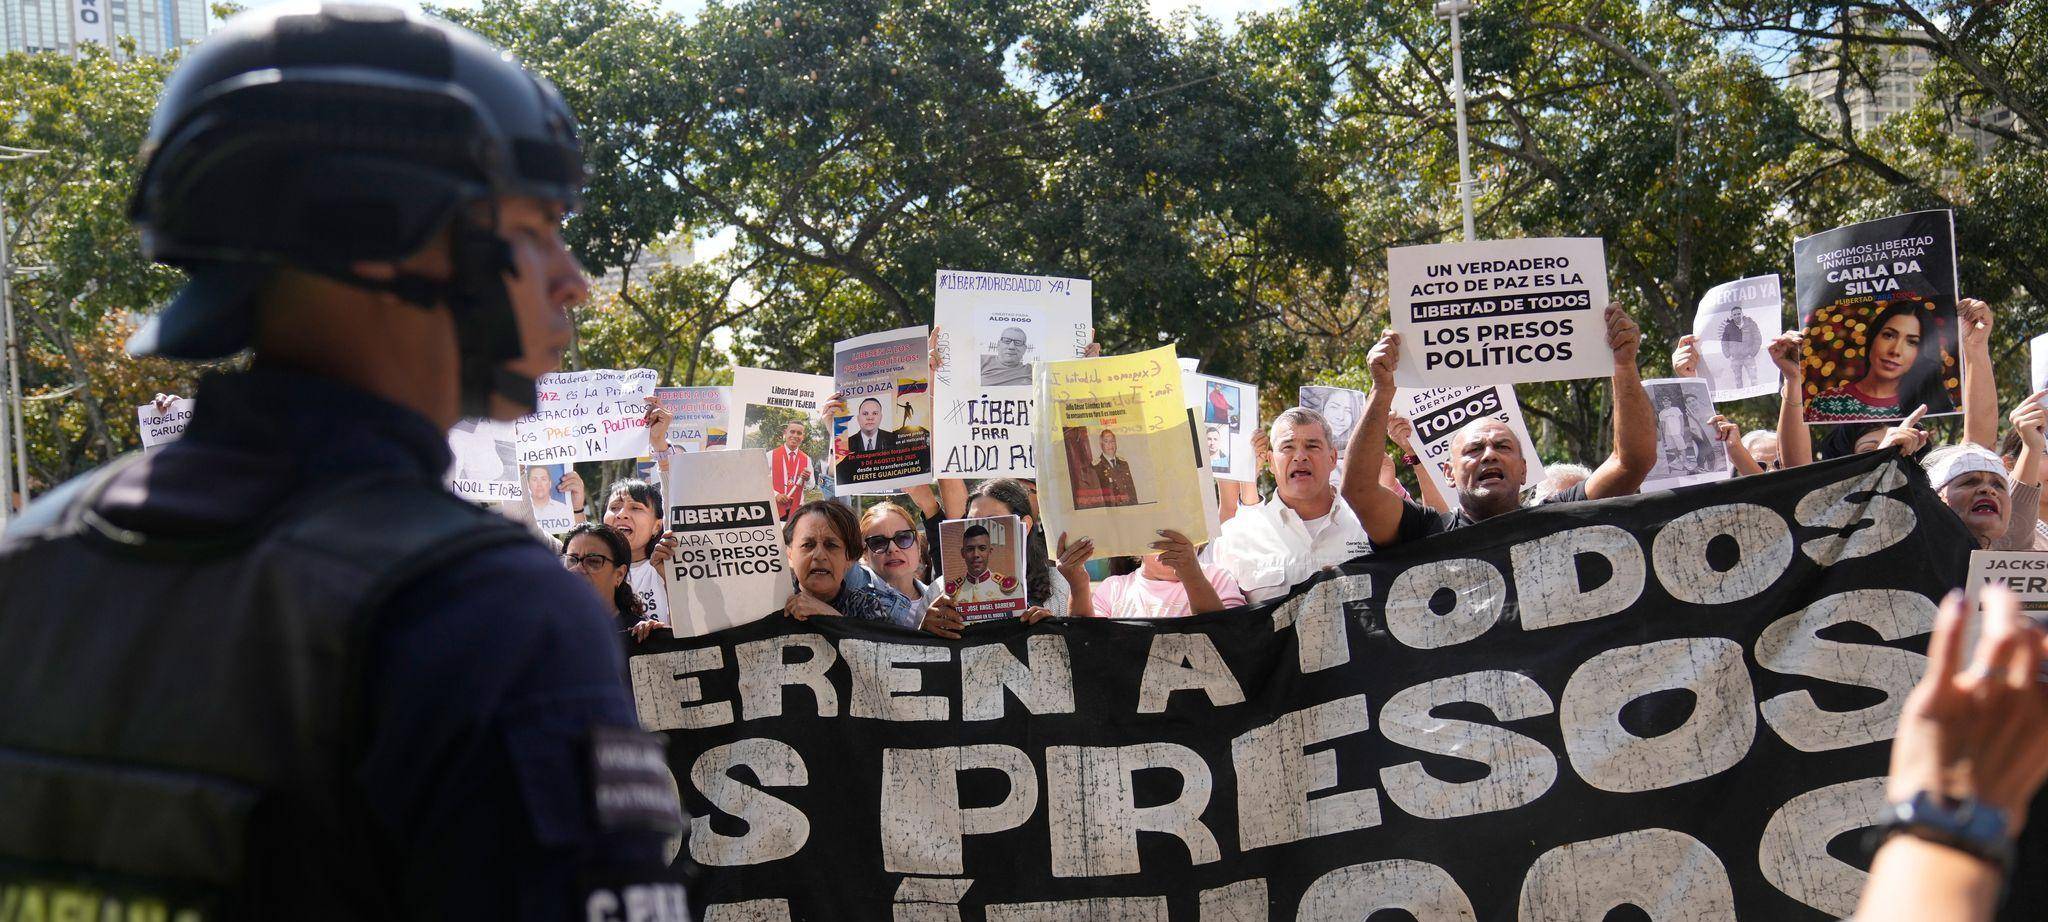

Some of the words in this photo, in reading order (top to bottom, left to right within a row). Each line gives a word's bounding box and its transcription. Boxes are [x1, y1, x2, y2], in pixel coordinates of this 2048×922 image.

[1816, 244, 1873, 264] EXIGIMOS
[1875, 236, 1934, 252] LIBERTAD
[1823, 251, 1889, 270] INMEDIATA
[1891, 247, 1925, 260] PARA
[1427, 264, 1452, 277] UN
[1457, 256, 1569, 275] VERDADERO
[1826, 263, 1889, 283] CARLA
[1893, 260, 1921, 275] DA
[1410, 282, 1459, 297] ACTO
[1464, 279, 1488, 292] DE
[1494, 276, 1529, 290] PAZ
[1534, 274, 1555, 287] ES
[1561, 273, 1584, 285] LA
[1760, 282, 1777, 298] YA
[1845, 278, 1900, 296] SILVA
[1412, 301, 1497, 320] LIBERTAD
[1501, 298, 1524, 312] DE
[1528, 294, 1589, 310] TODOS
[1424, 327, 1470, 346] LOS
[1477, 319, 1574, 341] PRESOS
[1426, 342, 1573, 371] POLÍTICOS
[771, 386, 798, 397] Libertad
[799, 389, 815, 399] para
[840, 387, 864, 397] USTO
[867, 382, 893, 393] DAZA
[767, 397, 794, 408] KENNEDY
[795, 399, 816, 410] TEJEDA
[1409, 390, 1462, 416] LIBERTAD
[1417, 393, 1498, 438] TODOS
[672, 429, 702, 439] DAZA
[971, 427, 1008, 440] PARA
[586, 436, 609, 456] YA!
[1425, 440, 1449, 459] LOS
[856, 466, 872, 474] desde
[880, 461, 913, 470] transferencia
[941, 444, 998, 472] ALDO
[852, 472, 877, 481] FUERTE
[877, 466, 921, 478] GUAICAIPURO
[671, 506, 766, 525] LIBERTAD
[716, 529, 776, 544] TODOS
[672, 549, 706, 565] LOS
[710, 544, 780, 561] PRESOS
[1985, 559, 2048, 570] JACKS
[675, 559, 782, 581] POLÍTICOS
[1136, 632, 1246, 714] A
[1273, 461, 1917, 674] TODOS
[1984, 576, 2048, 593] VER
[880, 588, 1938, 878] PRESOS
